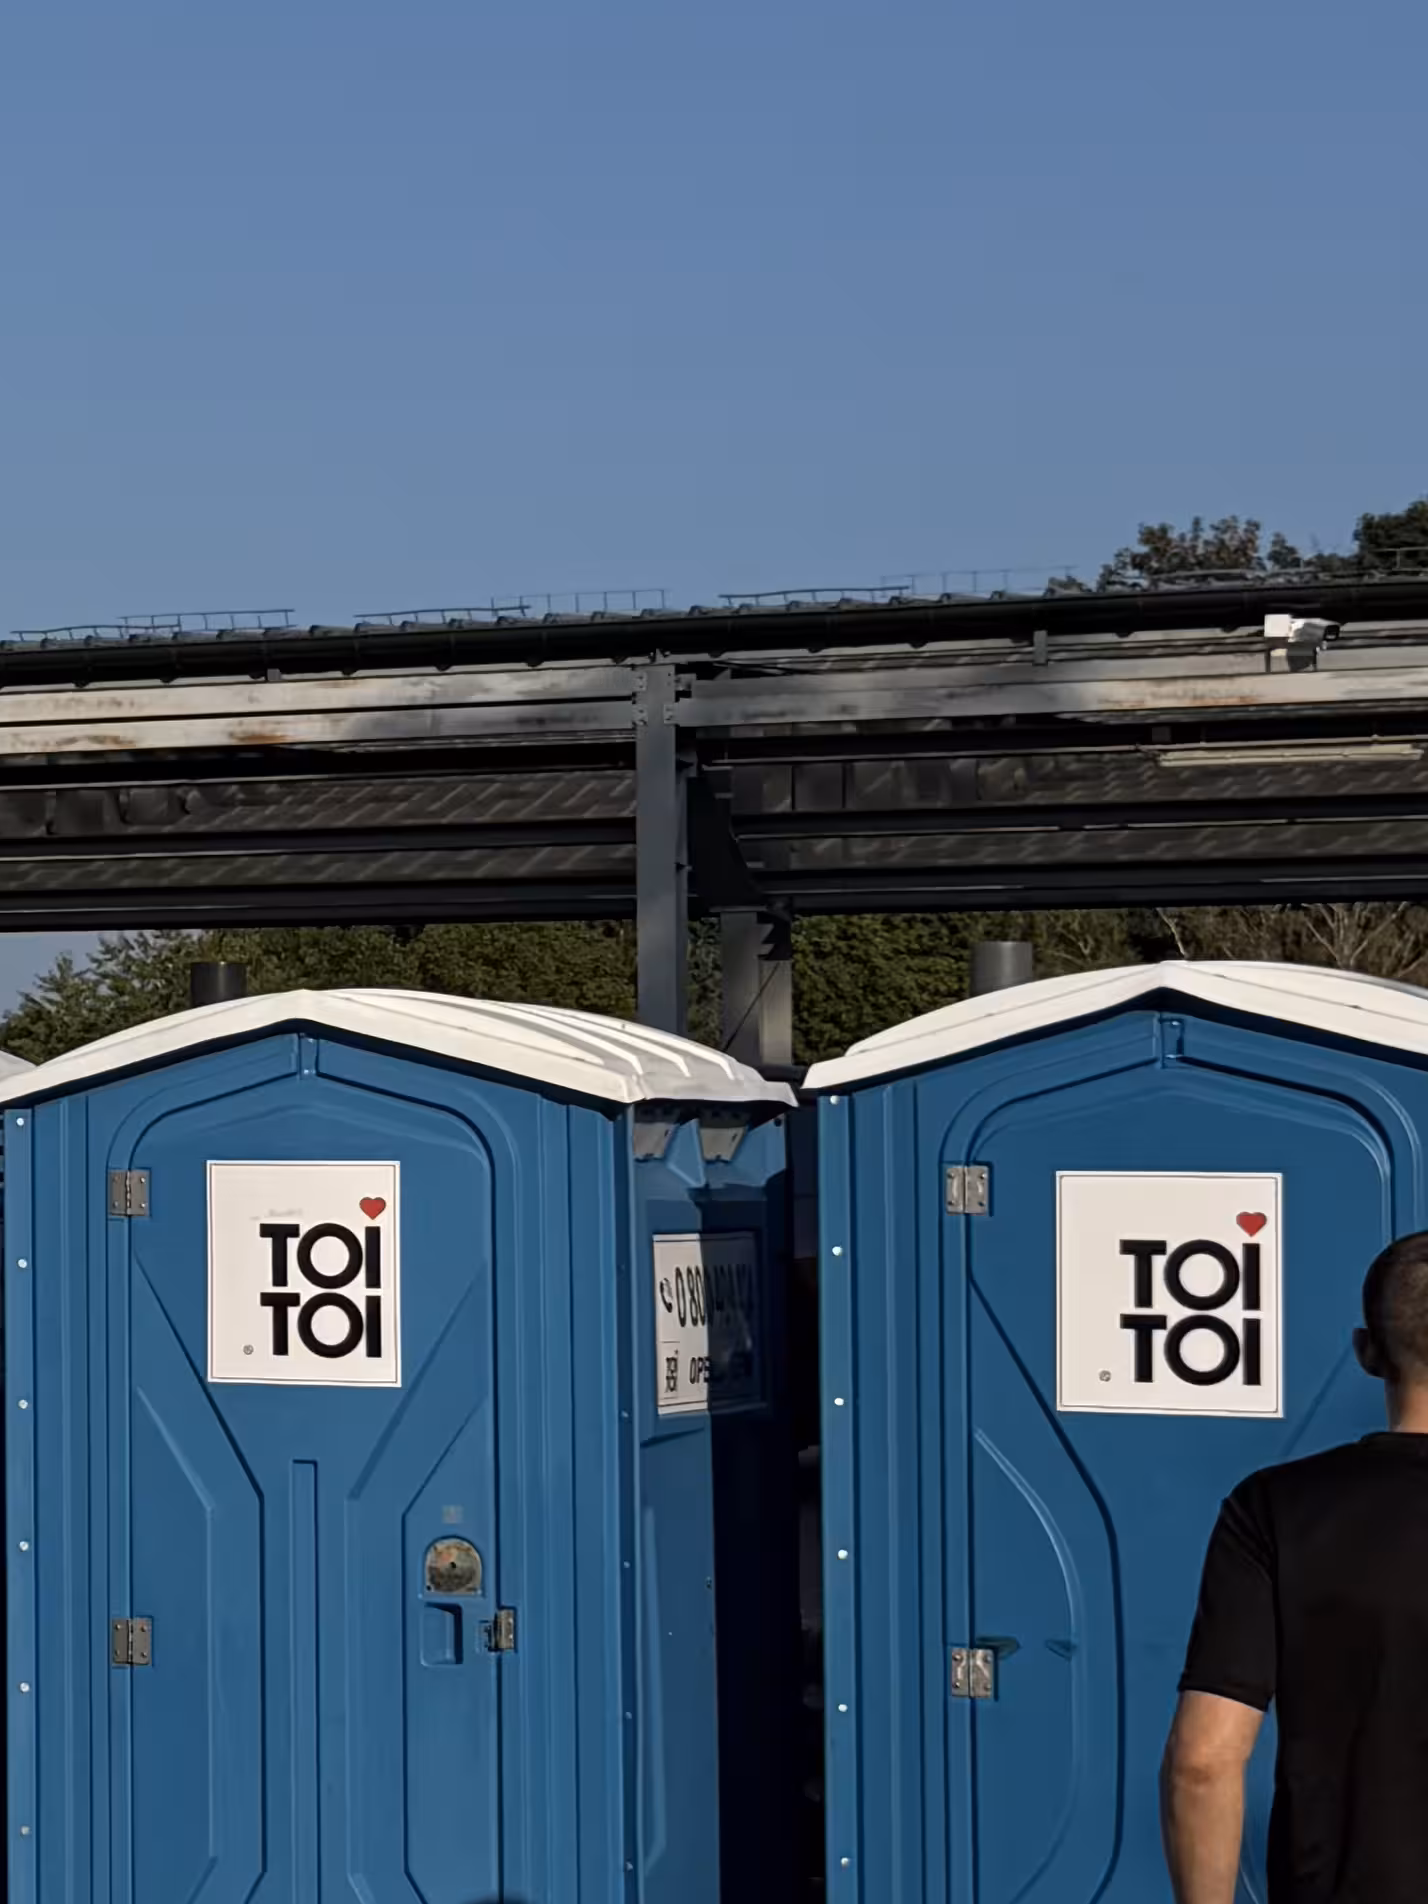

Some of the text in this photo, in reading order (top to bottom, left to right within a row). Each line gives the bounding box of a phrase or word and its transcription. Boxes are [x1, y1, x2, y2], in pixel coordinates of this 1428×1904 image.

[260, 1222, 381, 1289] TOI
[1119, 1239, 1261, 1311] TOI
[260, 1292, 382, 1359] TOI
[675, 1266, 687, 1327] 0
[1120, 1314, 1261, 1386] TOI
